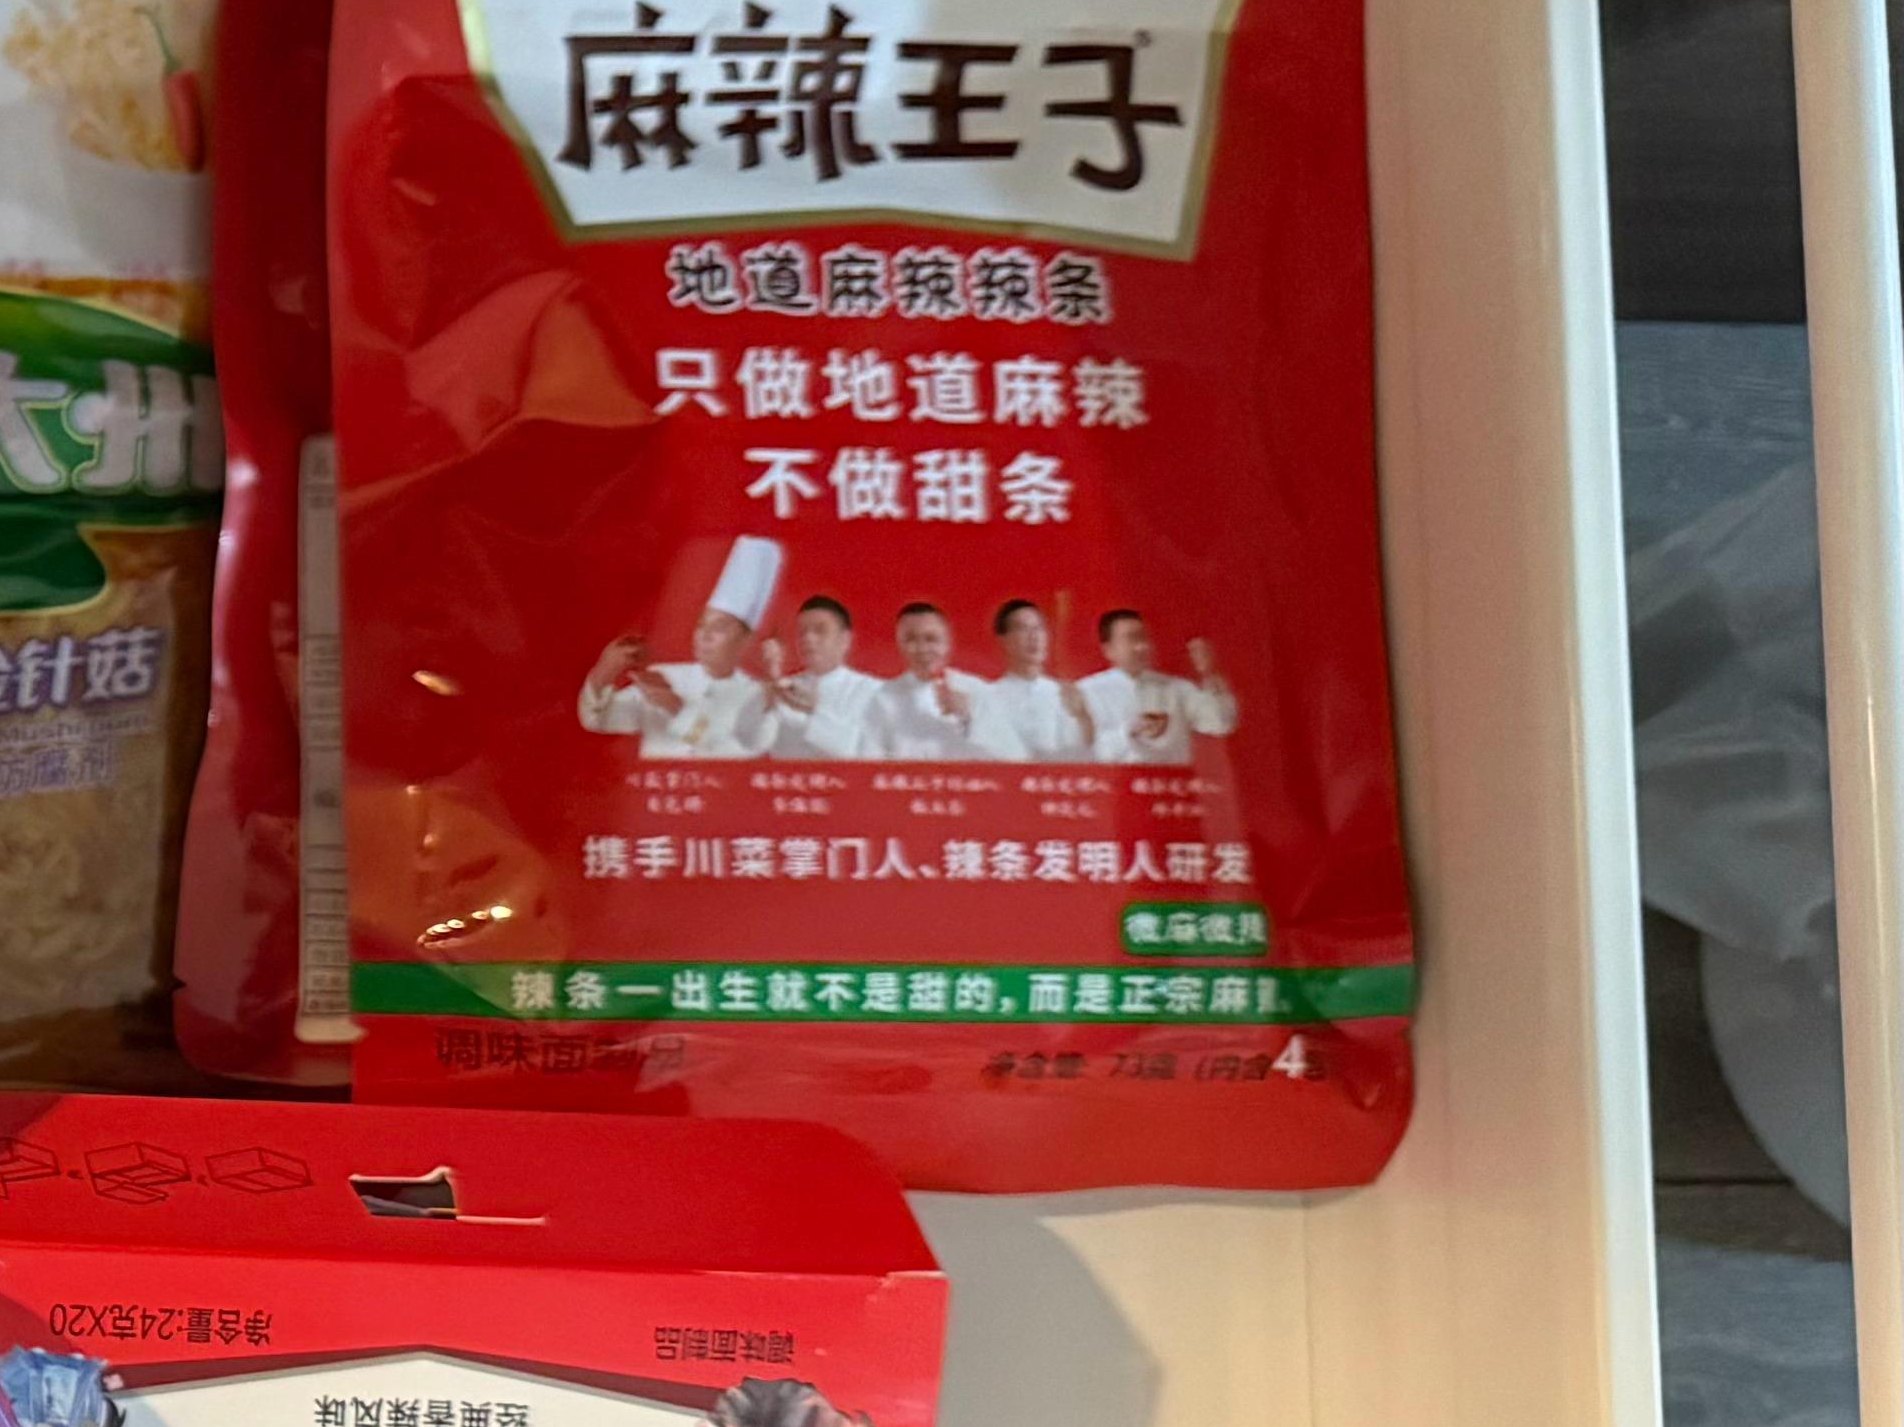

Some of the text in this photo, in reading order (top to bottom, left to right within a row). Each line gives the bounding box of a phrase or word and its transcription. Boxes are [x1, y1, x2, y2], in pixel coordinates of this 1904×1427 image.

[558, 2, 1183, 191] 麻辣王子
[668, 247, 1112, 326] 地道麻辣辣条
[654, 348, 1147, 428] 只做地道麻辣
[745, 447, 1075, 524] 不做甜条
[654, 1327, 794, 1364] 调味面制品
